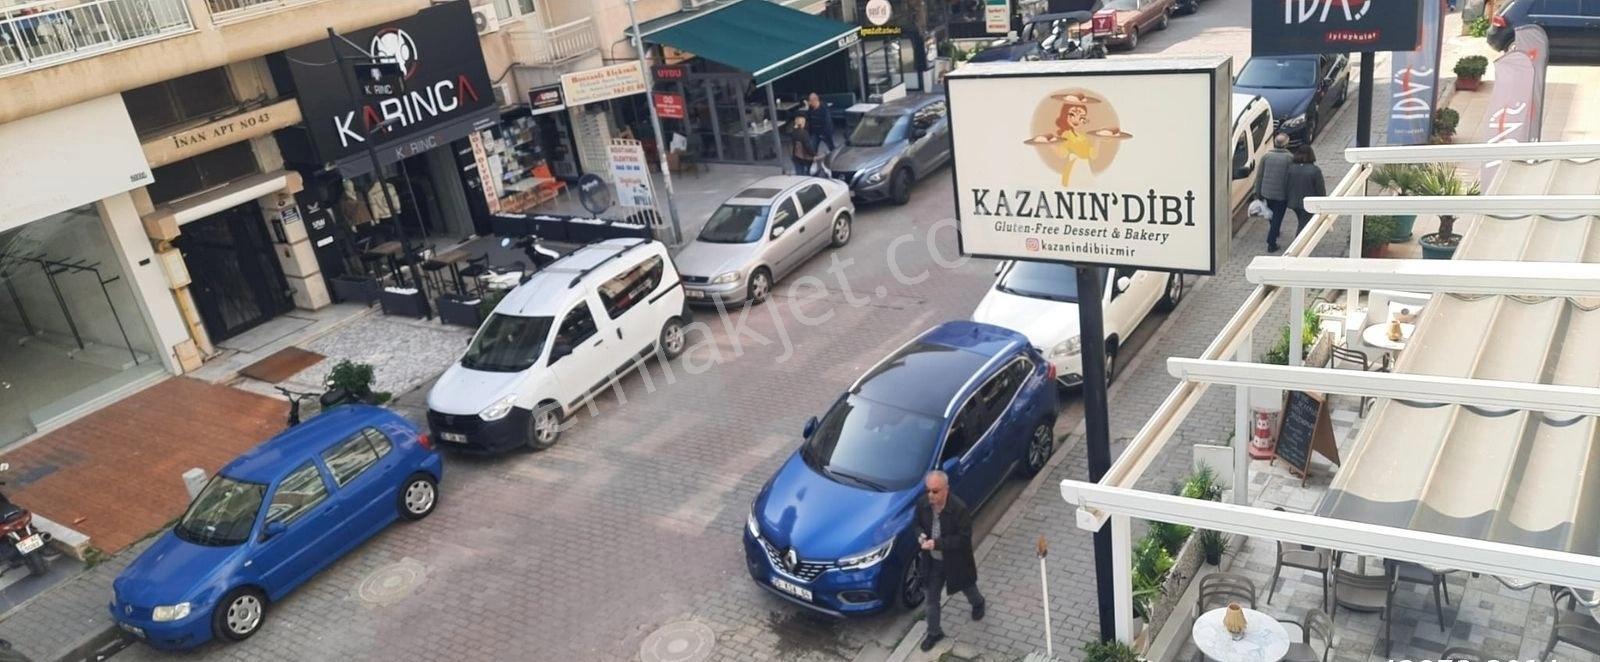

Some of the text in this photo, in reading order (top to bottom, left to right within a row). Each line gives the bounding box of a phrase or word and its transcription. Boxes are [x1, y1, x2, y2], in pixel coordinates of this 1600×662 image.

[334, 74, 479, 148] KARINCA
[213, 123, 235, 138] APT
[240, 117, 257, 130] NO
[258, 113, 270, 124] 43
[994, 220, 1170, 244] Gluten-Free Dessert & Bakery
[1041, 239, 1136, 257] kazanindibiizmir
